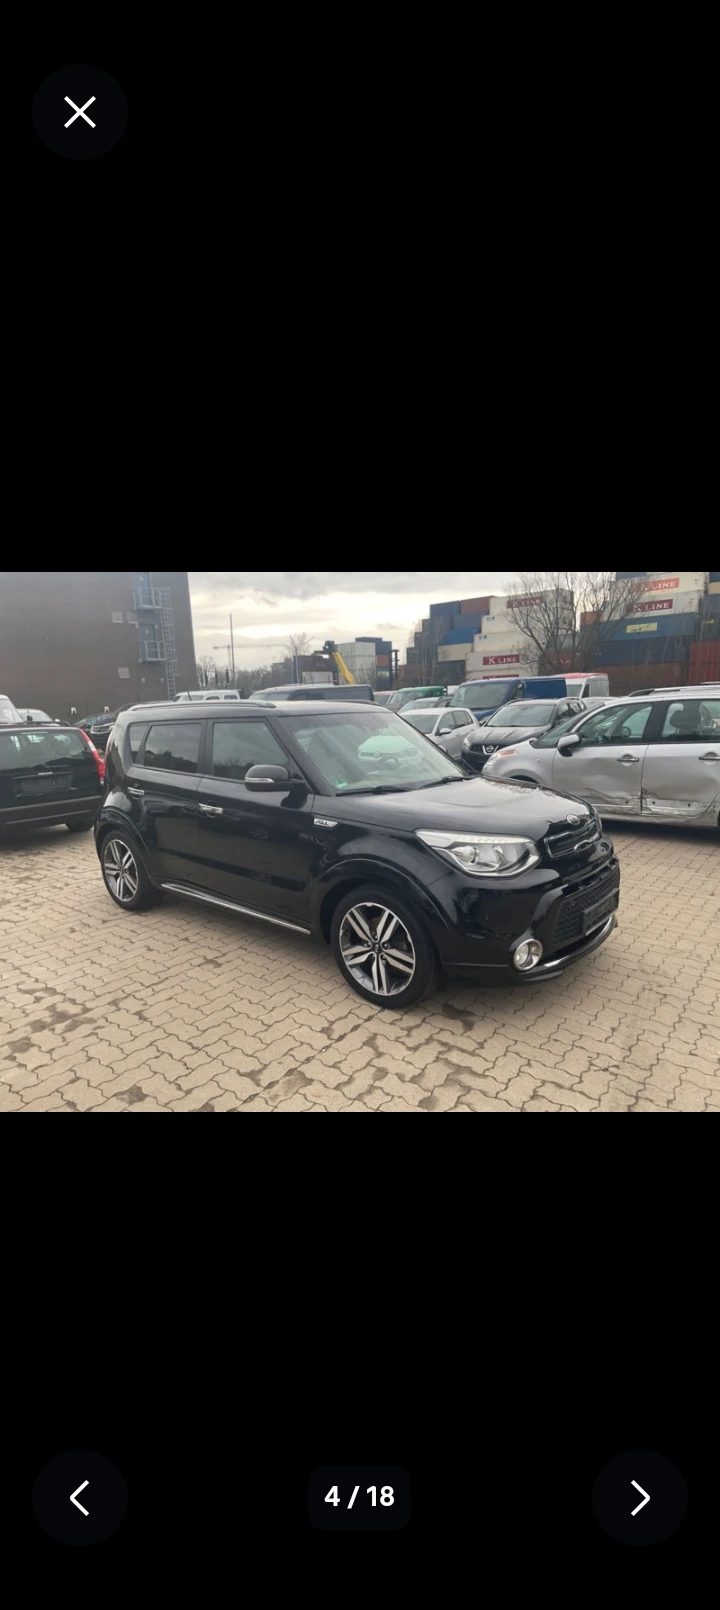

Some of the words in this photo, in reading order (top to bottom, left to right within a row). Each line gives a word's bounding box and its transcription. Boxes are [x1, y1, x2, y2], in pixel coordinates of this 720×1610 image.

[651, 581, 676, 590] LINE
[632, 603, 643, 612] K
[645, 602, 670, 611] LINE
[488, 656, 496, 665] K
[497, 656, 517, 664] LINE
